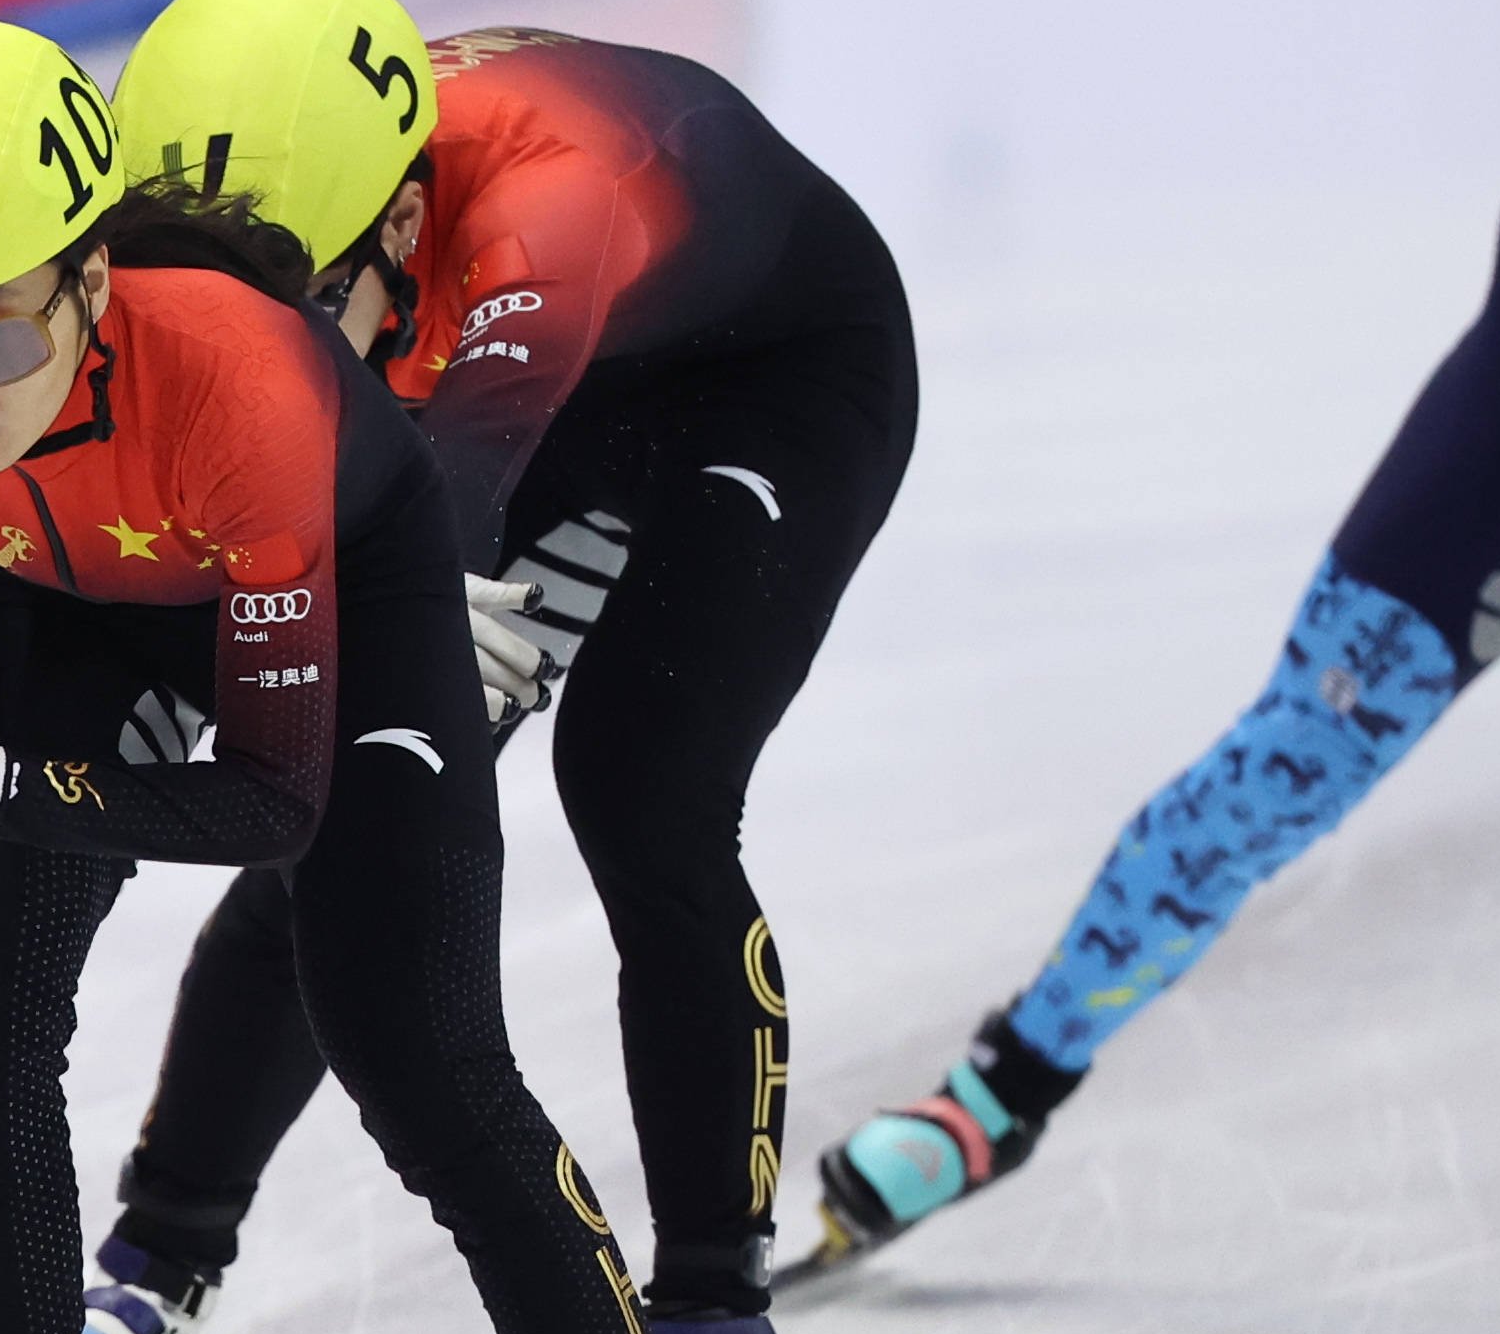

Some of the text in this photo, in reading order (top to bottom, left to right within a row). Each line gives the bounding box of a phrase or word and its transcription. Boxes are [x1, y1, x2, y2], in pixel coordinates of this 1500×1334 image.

[348, 26, 419, 135] 5
[39, 65, 116, 225] 10
[233, 630, 270, 644] Audi
[237, 663, 321, 688] 一汽奥迪
